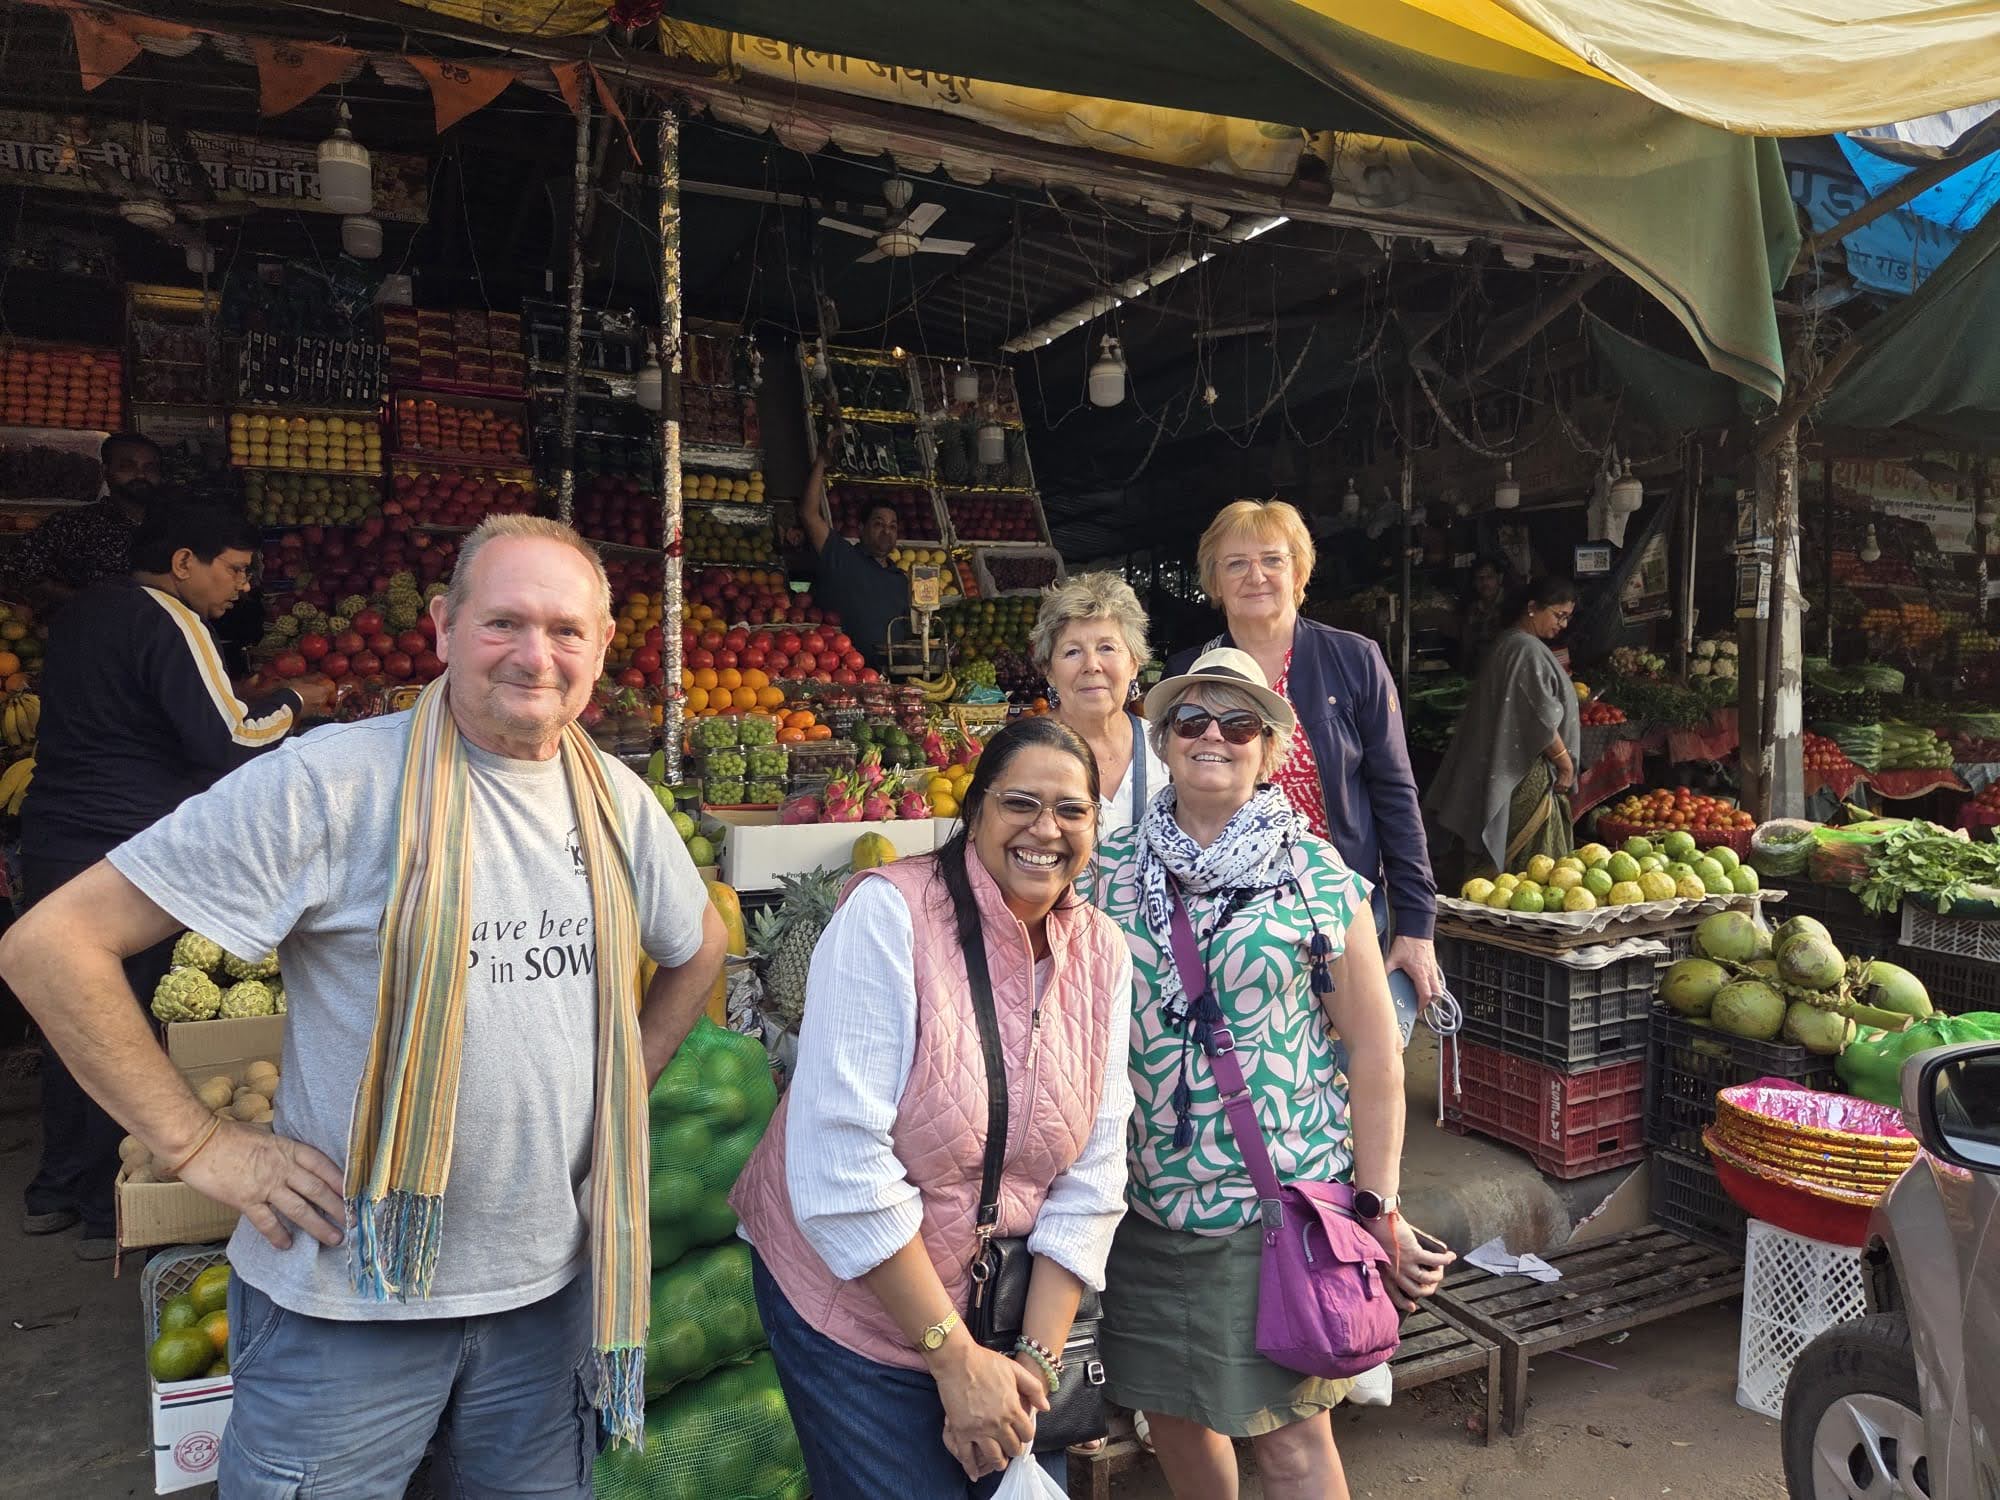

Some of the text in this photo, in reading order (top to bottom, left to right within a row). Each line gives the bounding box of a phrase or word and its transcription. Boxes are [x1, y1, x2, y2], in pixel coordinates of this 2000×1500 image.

[472, 909, 597, 942] ave bee
[490, 956, 514, 983] in
[525, 942, 598, 981] SOW
[1552, 1081, 1561, 1141] RAJESH
